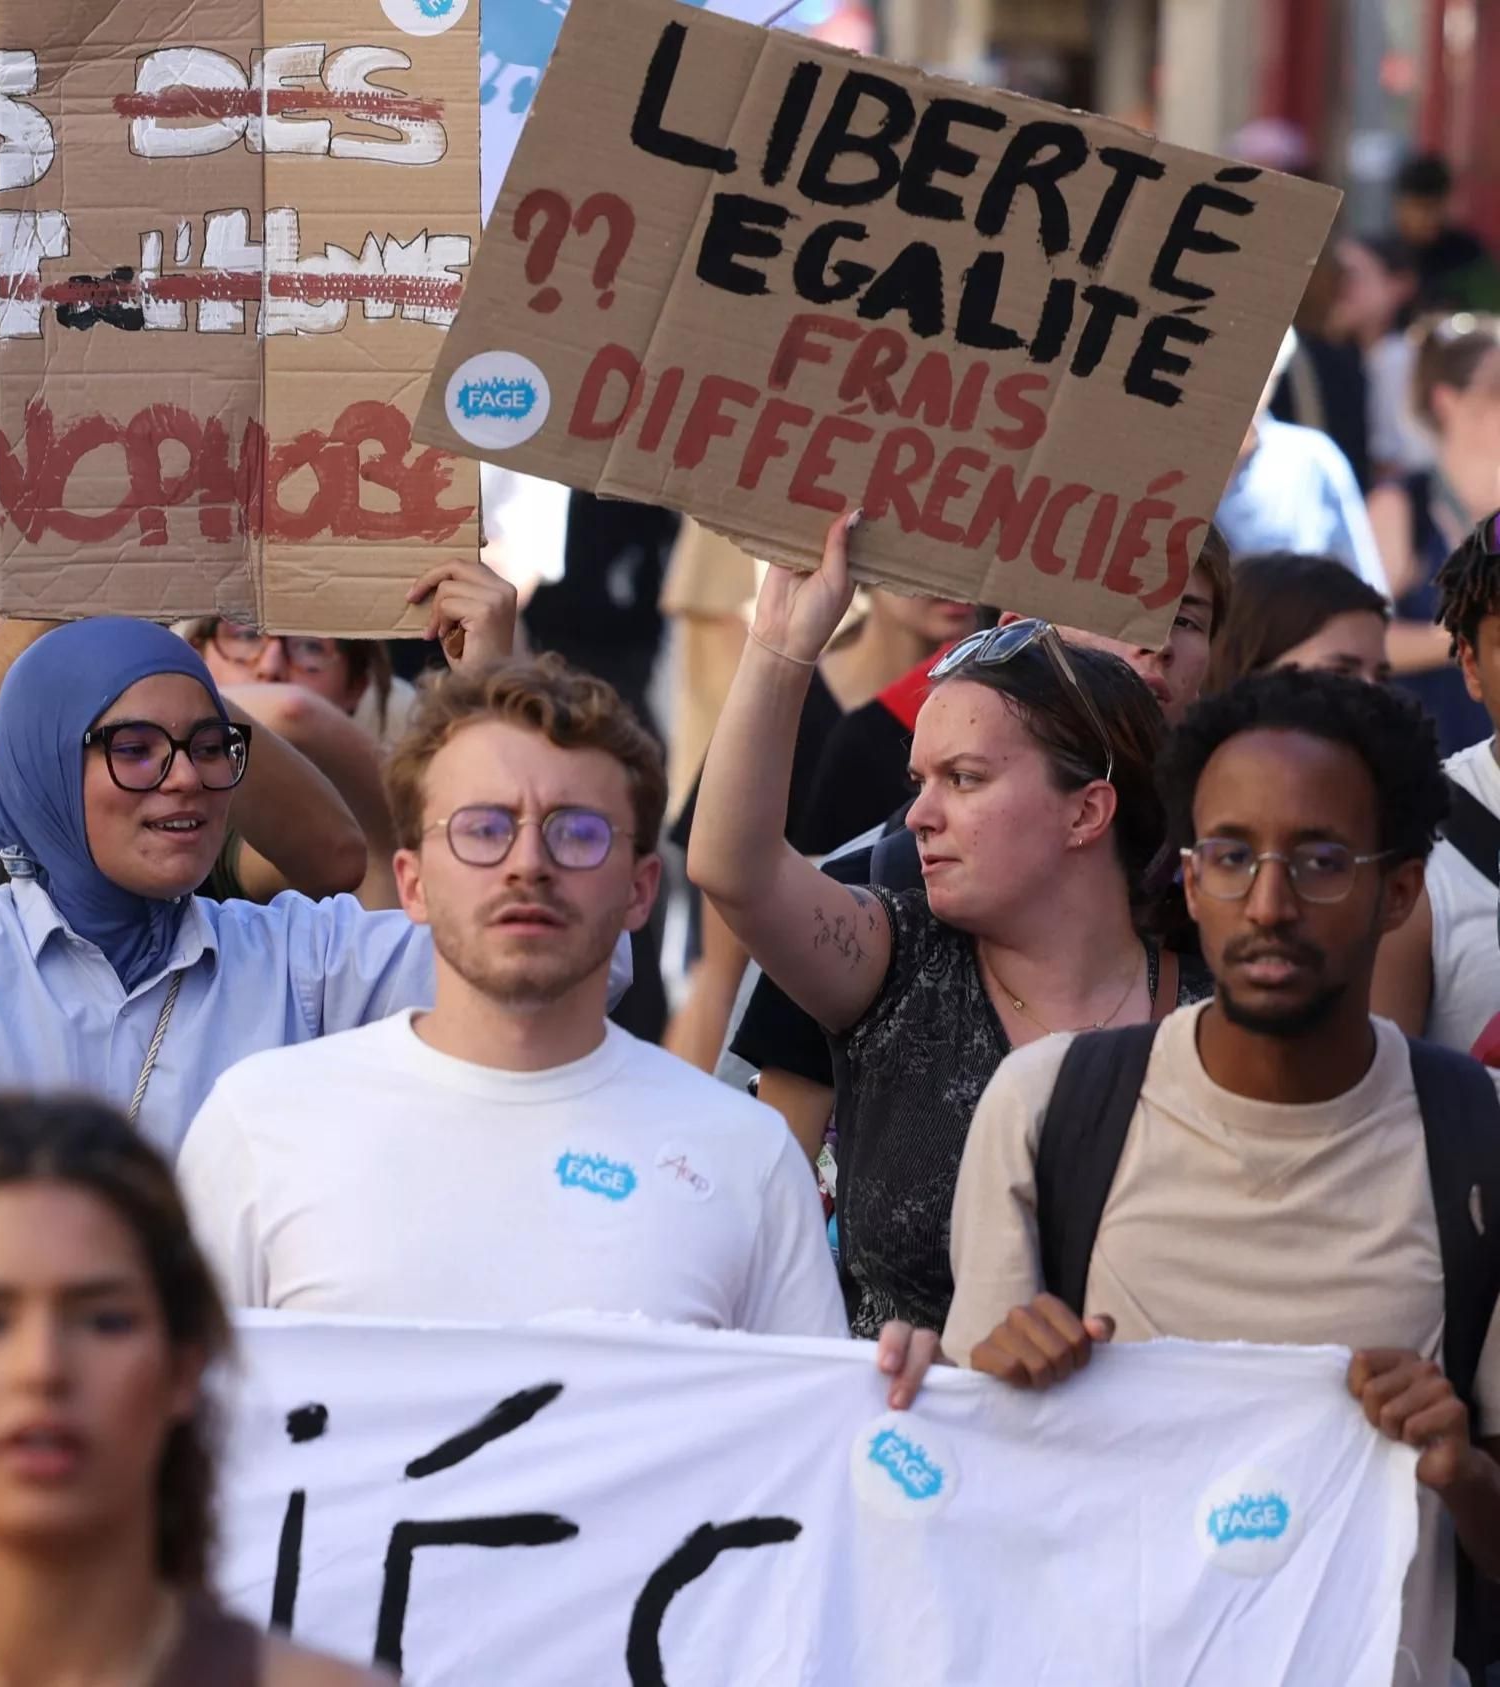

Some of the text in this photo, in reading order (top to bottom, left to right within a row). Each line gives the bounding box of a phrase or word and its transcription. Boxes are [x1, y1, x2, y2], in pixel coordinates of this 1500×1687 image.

[129, 44, 449, 166] DES
[630, 21, 1263, 301] LIBERTÉ
[512, 187, 635, 313] ??
[696, 193, 1216, 407] EGALITÉ
[468, 389, 527, 409] FAGE
[768, 313, 1052, 452] FRAIS
[566, 343, 1210, 612] DIFFÉRENCIÉS
[564, 1159, 628, 1193] FAGE
[877, 1436, 937, 1494] FAGE
[1215, 1503, 1281, 1535] FAGE
